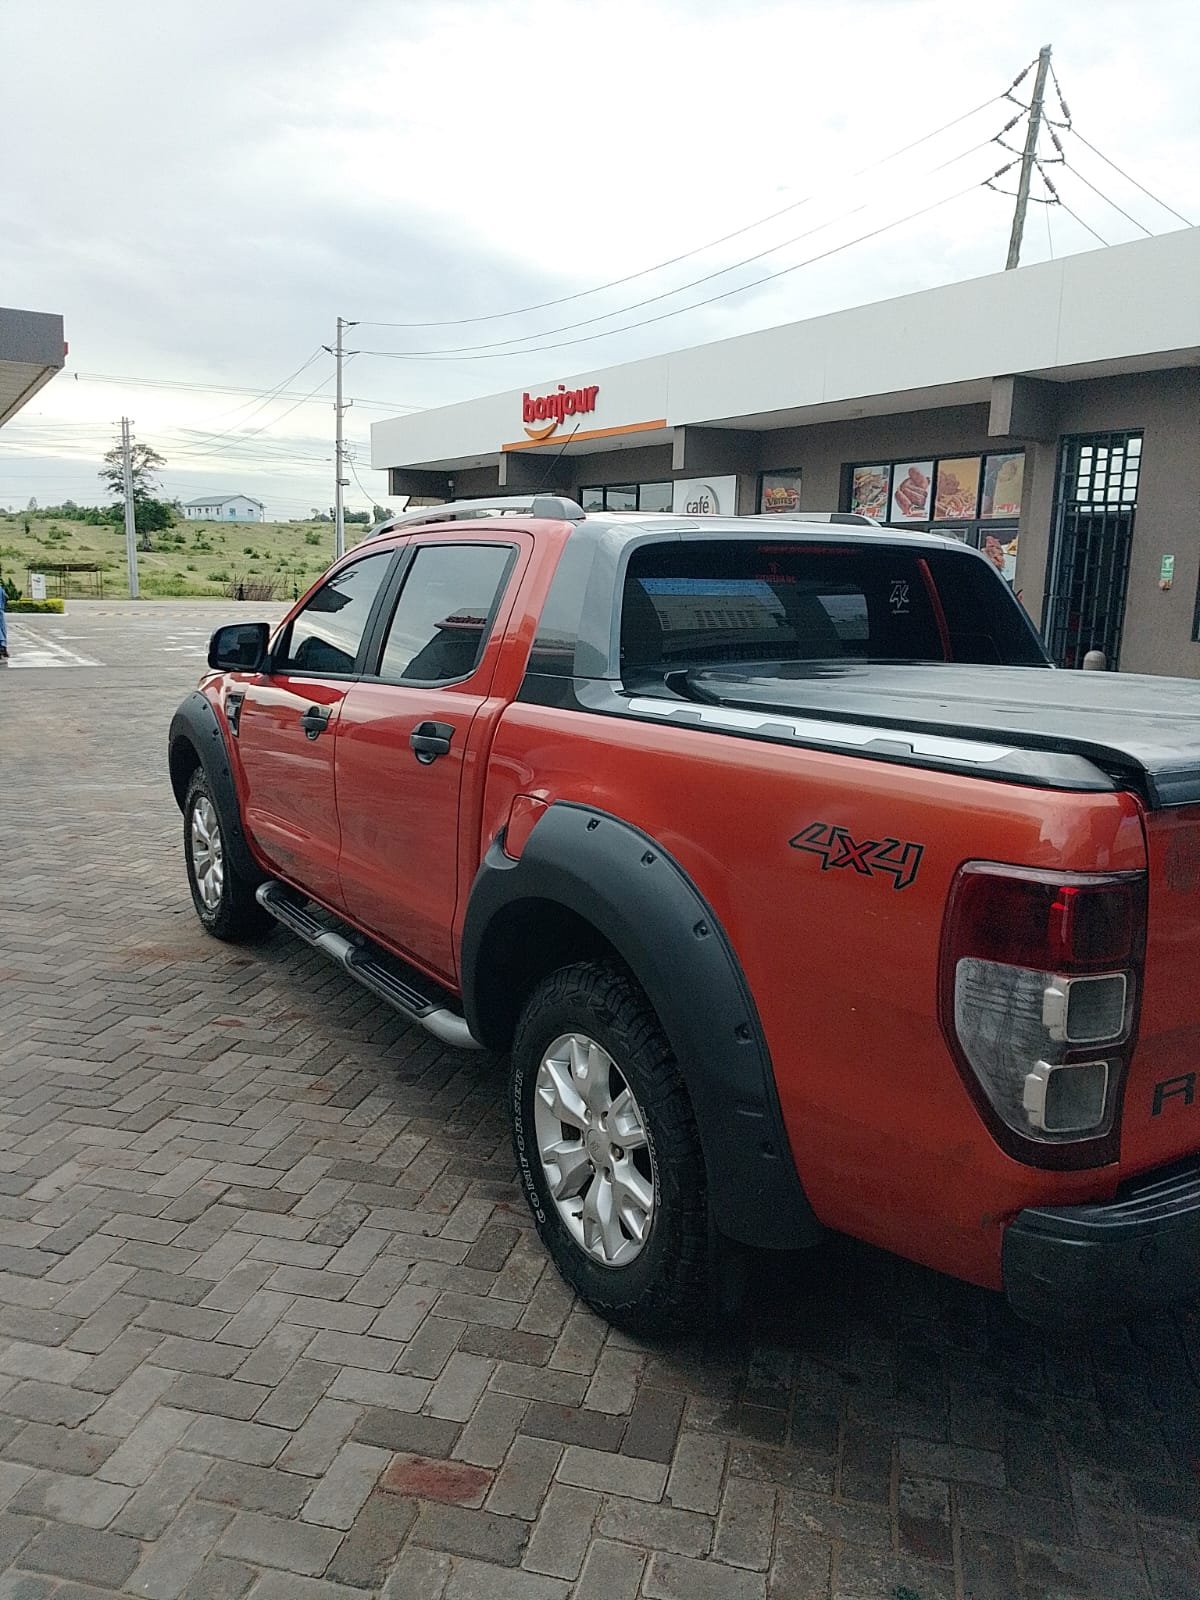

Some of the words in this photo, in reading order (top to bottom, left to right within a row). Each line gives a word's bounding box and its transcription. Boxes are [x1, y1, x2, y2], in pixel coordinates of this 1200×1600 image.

[523, 384, 599, 424] bonjour
[686, 495, 710, 514] café
[788, 822, 924, 890] 4x4
